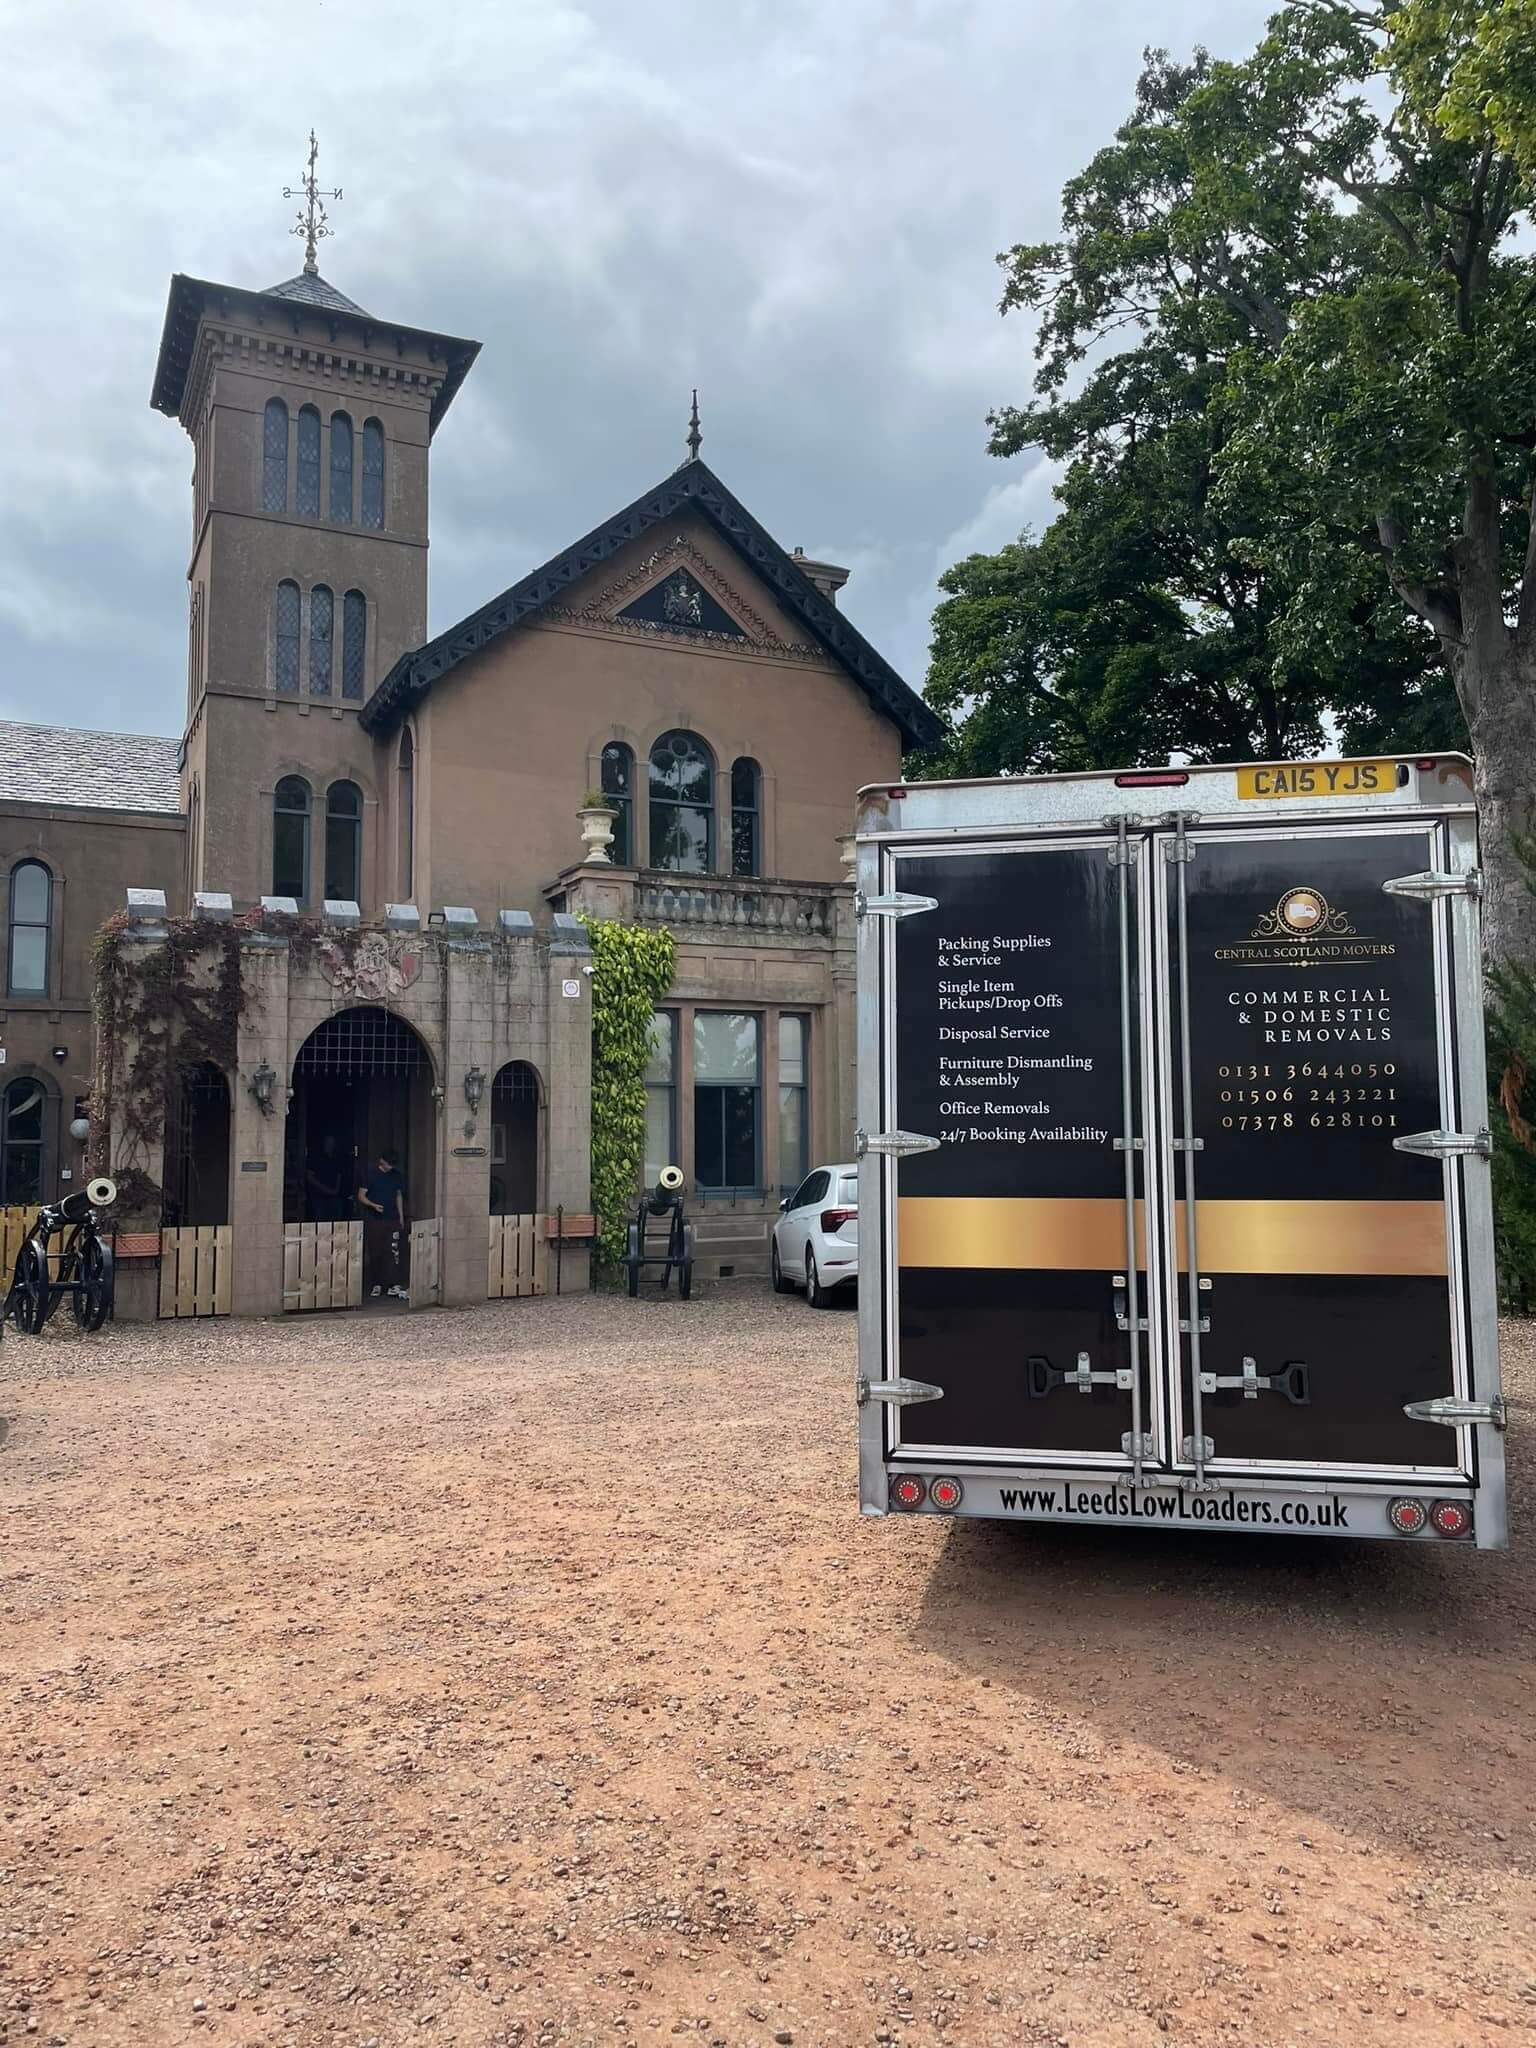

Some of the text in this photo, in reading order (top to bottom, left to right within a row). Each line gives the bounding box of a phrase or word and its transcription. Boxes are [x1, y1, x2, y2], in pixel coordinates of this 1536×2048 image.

[1255, 765, 1378, 794] CA15 YJS
[938, 934, 1052, 951] Packing Supplies
[938, 954, 1001, 966] & Service
[1214, 944, 1396, 960] CENTRAL SCOTLAND MOVERS
[938, 980, 1015, 996] Single Item
[1228, 988, 1390, 1005] COMMERCIAL
[938, 994, 1063, 1012] Pickups/Drop Offs
[1238, 1007, 1391, 1024] & DOMESTIC
[939, 1026, 1050, 1043] Disposal Service
[1264, 1027, 1392, 1042] REMOVALS
[939, 1055, 1093, 1071] Furniture Dismantling
[1219, 1061, 1395, 1080] 0131 3644050
[939, 1073, 1020, 1088] & Assembly
[1221, 1087, 1395, 1104] 01506 243221
[939, 1101, 1050, 1115] Office Removals
[1222, 1112, 1397, 1131] 07378 628101
[940, 1127, 1108, 1143] 24/7 Booking Availability
[999, 1482, 1349, 1527] www.LeedsLowLoaders.co.uk
